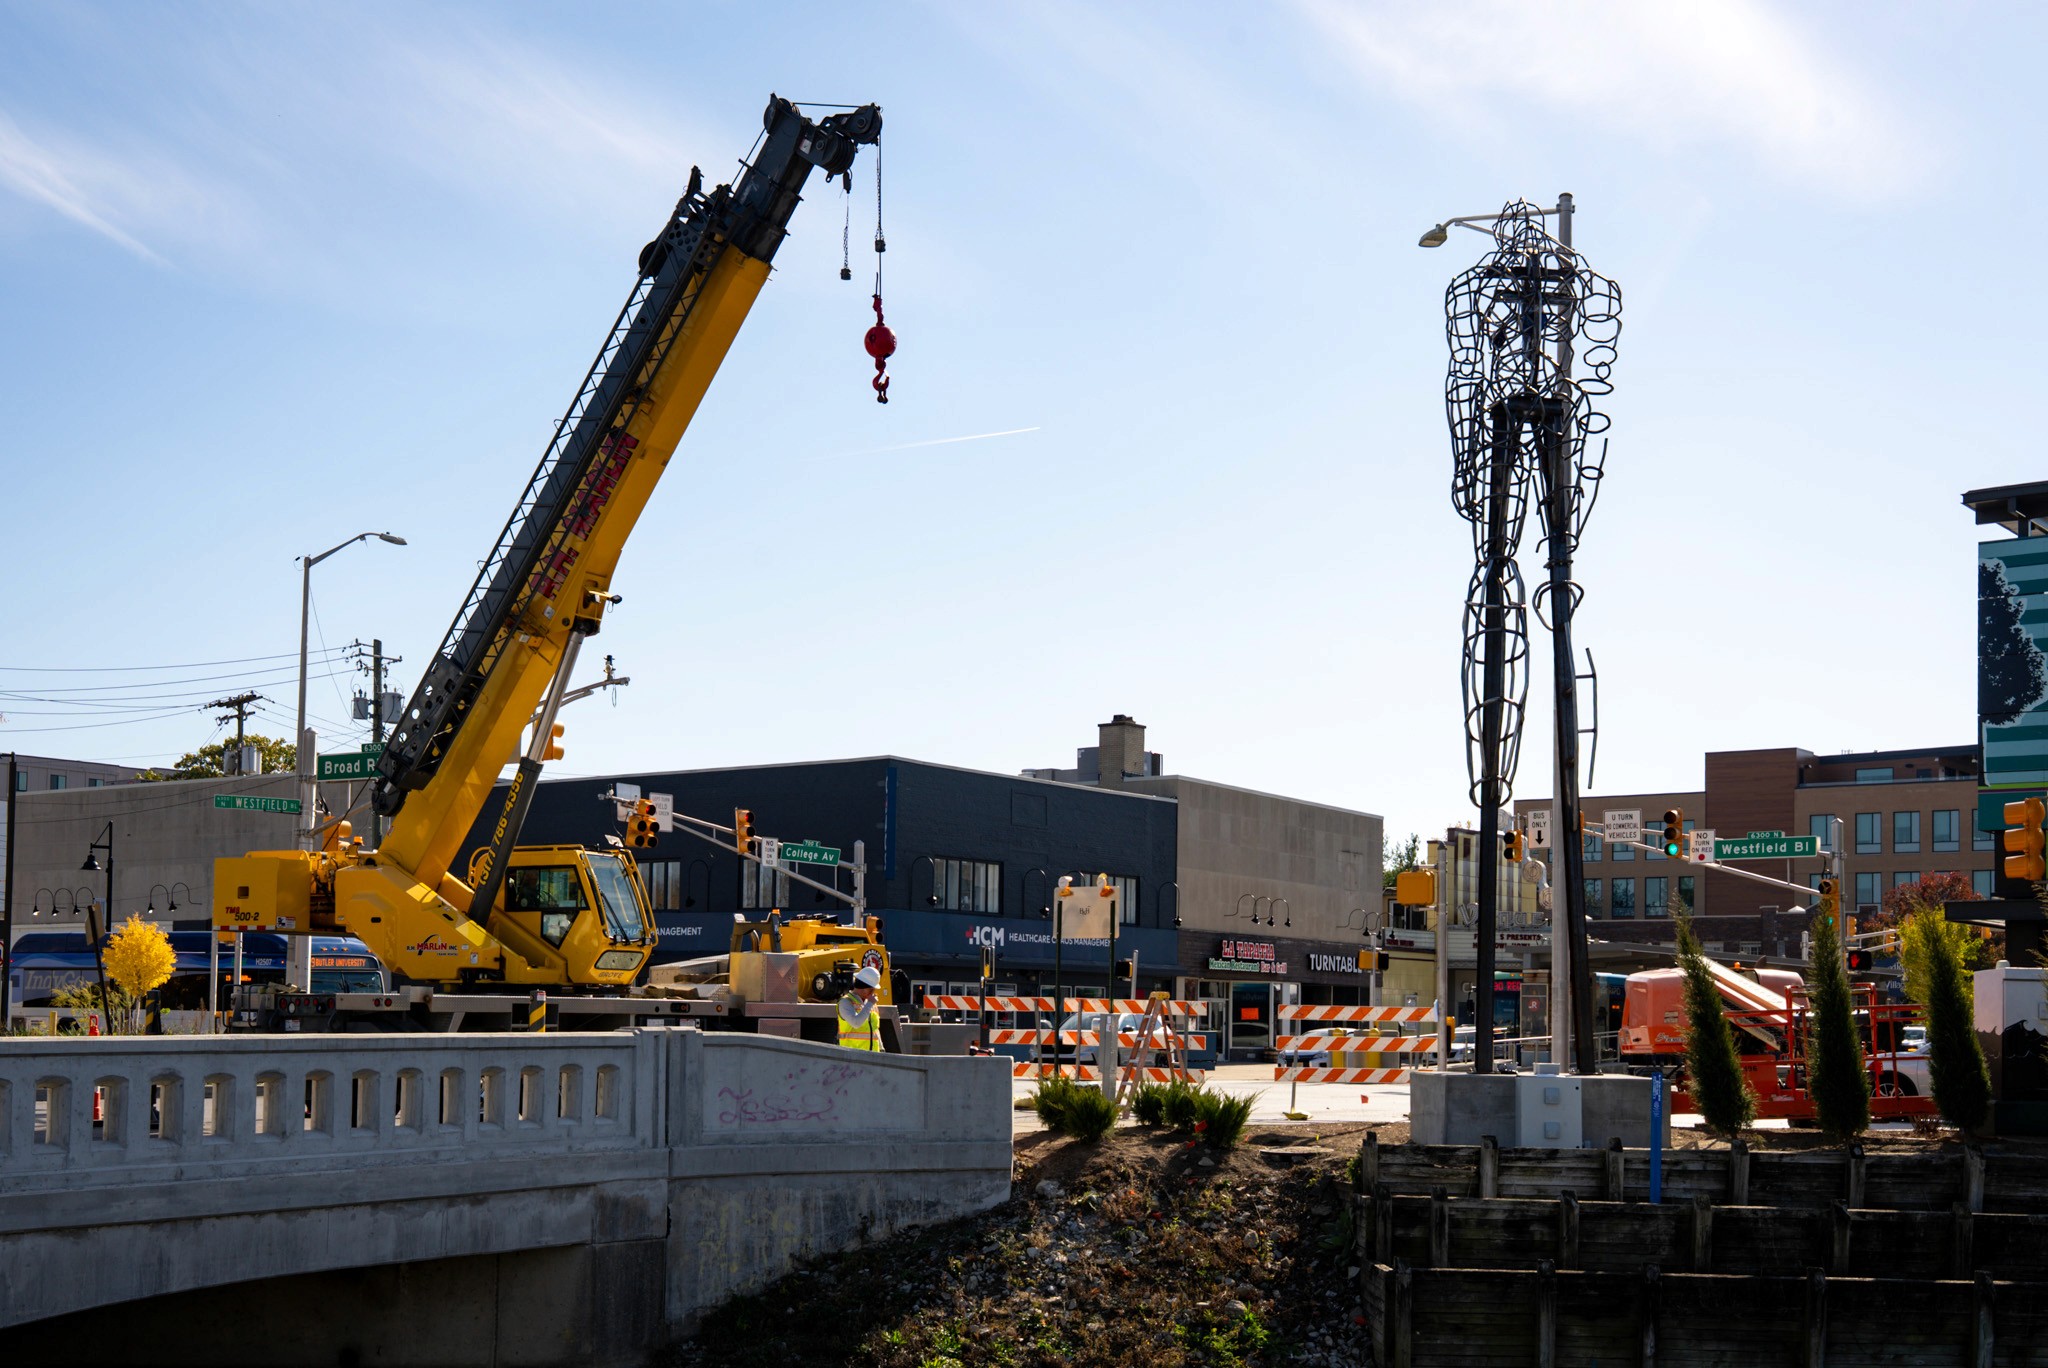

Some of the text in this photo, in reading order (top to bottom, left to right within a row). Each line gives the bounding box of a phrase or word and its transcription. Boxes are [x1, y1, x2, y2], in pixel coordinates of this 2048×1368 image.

[562, 432, 640, 541] MARLIN
[364, 744, 382, 752] 6300
[324, 759, 361, 774] Broad
[235, 797, 288, 811] WESTFIELD
[479, 772, 524, 885] (317) 786-4356
[1613, 822, 1639, 830] COMMERCIAL
[1609, 831, 1637, 839] VEHICLES
[786, 847, 835, 861] College Av
[1721, 841, 1809, 855] Westfield Bl
[235, 912, 260, 921] 500-2
[966, 925, 1005, 947] HCM
[1008, 932, 1050, 944] HEALTHCARE
[1051, 936, 1073, 945] CAOS
[1506, 933, 1542, 941] PRESENTS
[1222, 940, 1275, 961] LA TAPATIA
[255, 958, 272, 966] H2507
[315, 957, 335, 967] BUTLER
[336, 957, 366, 967] UNIVERSITY
[1208, 957, 1231, 970] Mexican
[1231, 959, 1260, 972] Restaurant
[1260, 961, 1271, 973] Bar
[1276, 962, 1288, 974] Grill
[1309, 953, 1363, 973] TURNTABL
